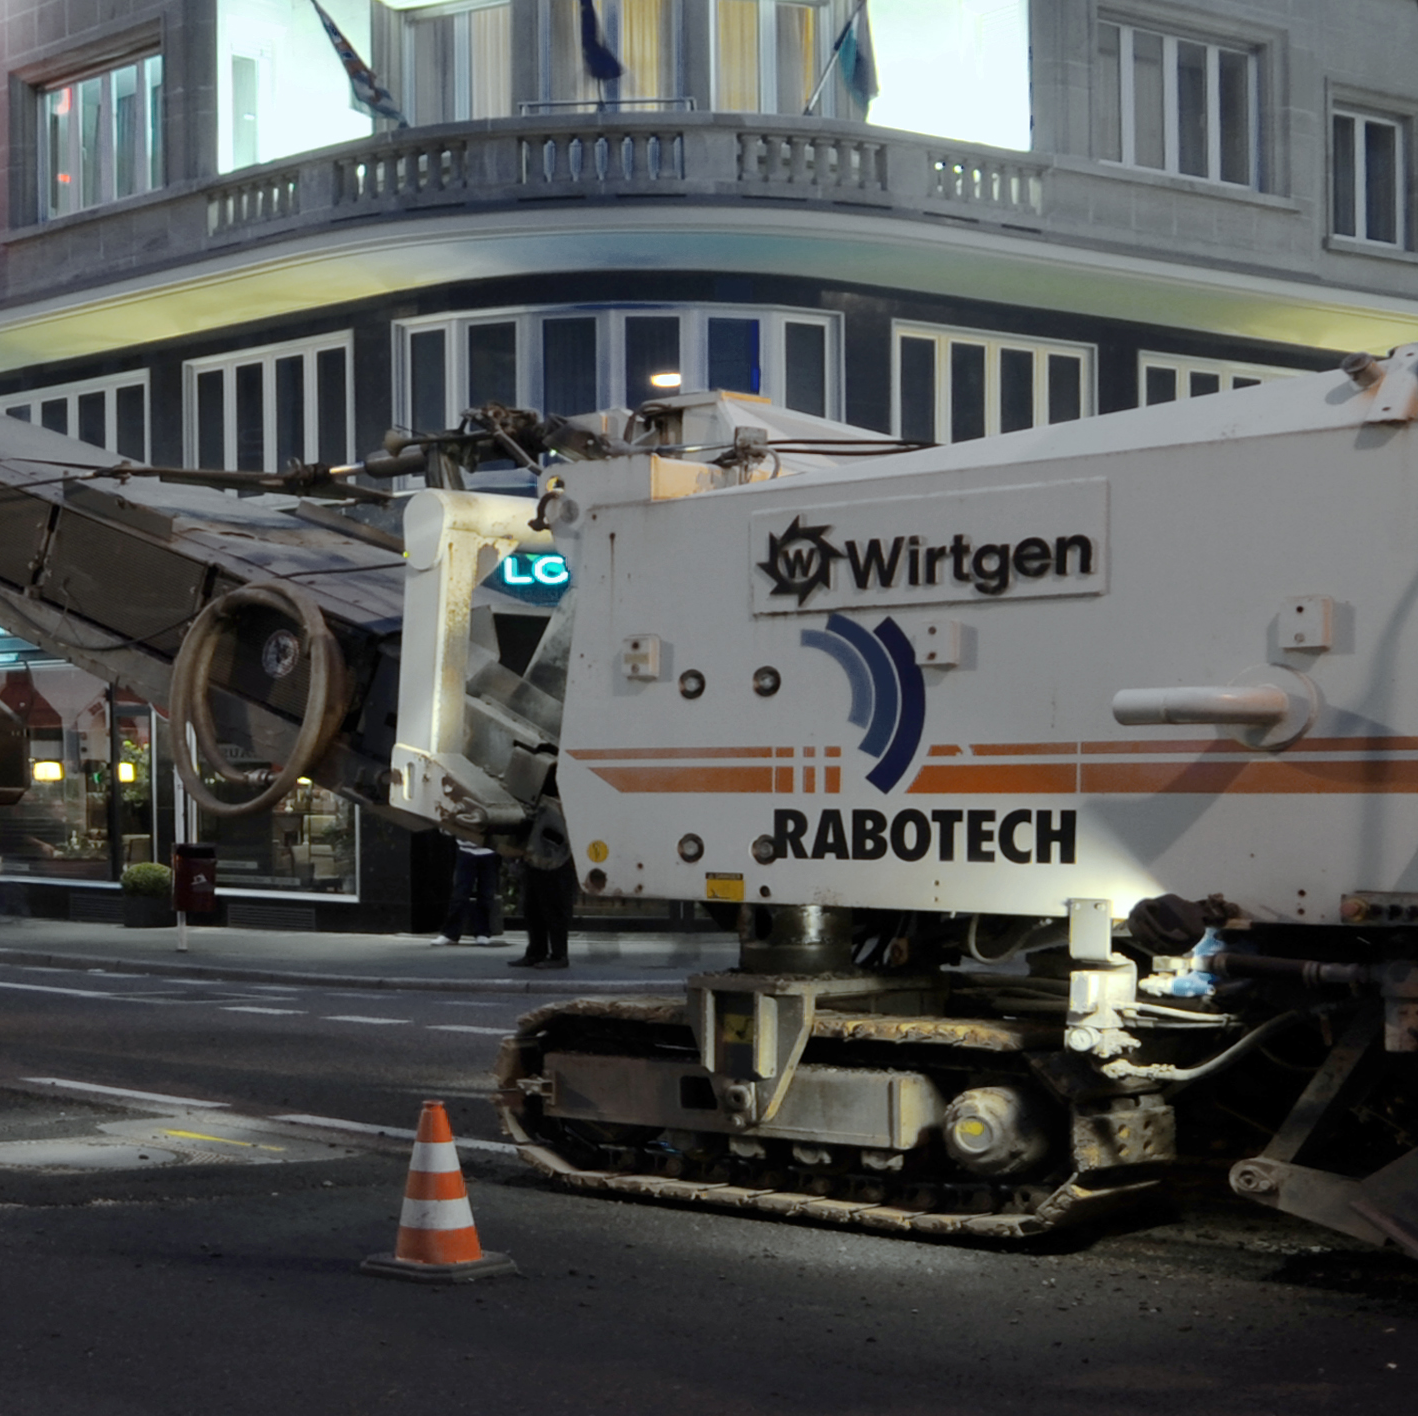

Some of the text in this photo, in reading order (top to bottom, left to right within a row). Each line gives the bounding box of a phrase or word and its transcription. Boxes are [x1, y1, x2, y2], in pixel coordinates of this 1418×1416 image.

[783, 548, 816, 579] W
[845, 534, 1094, 596] Wirtgen
[773, 808, 1077, 865] RABOTECH
